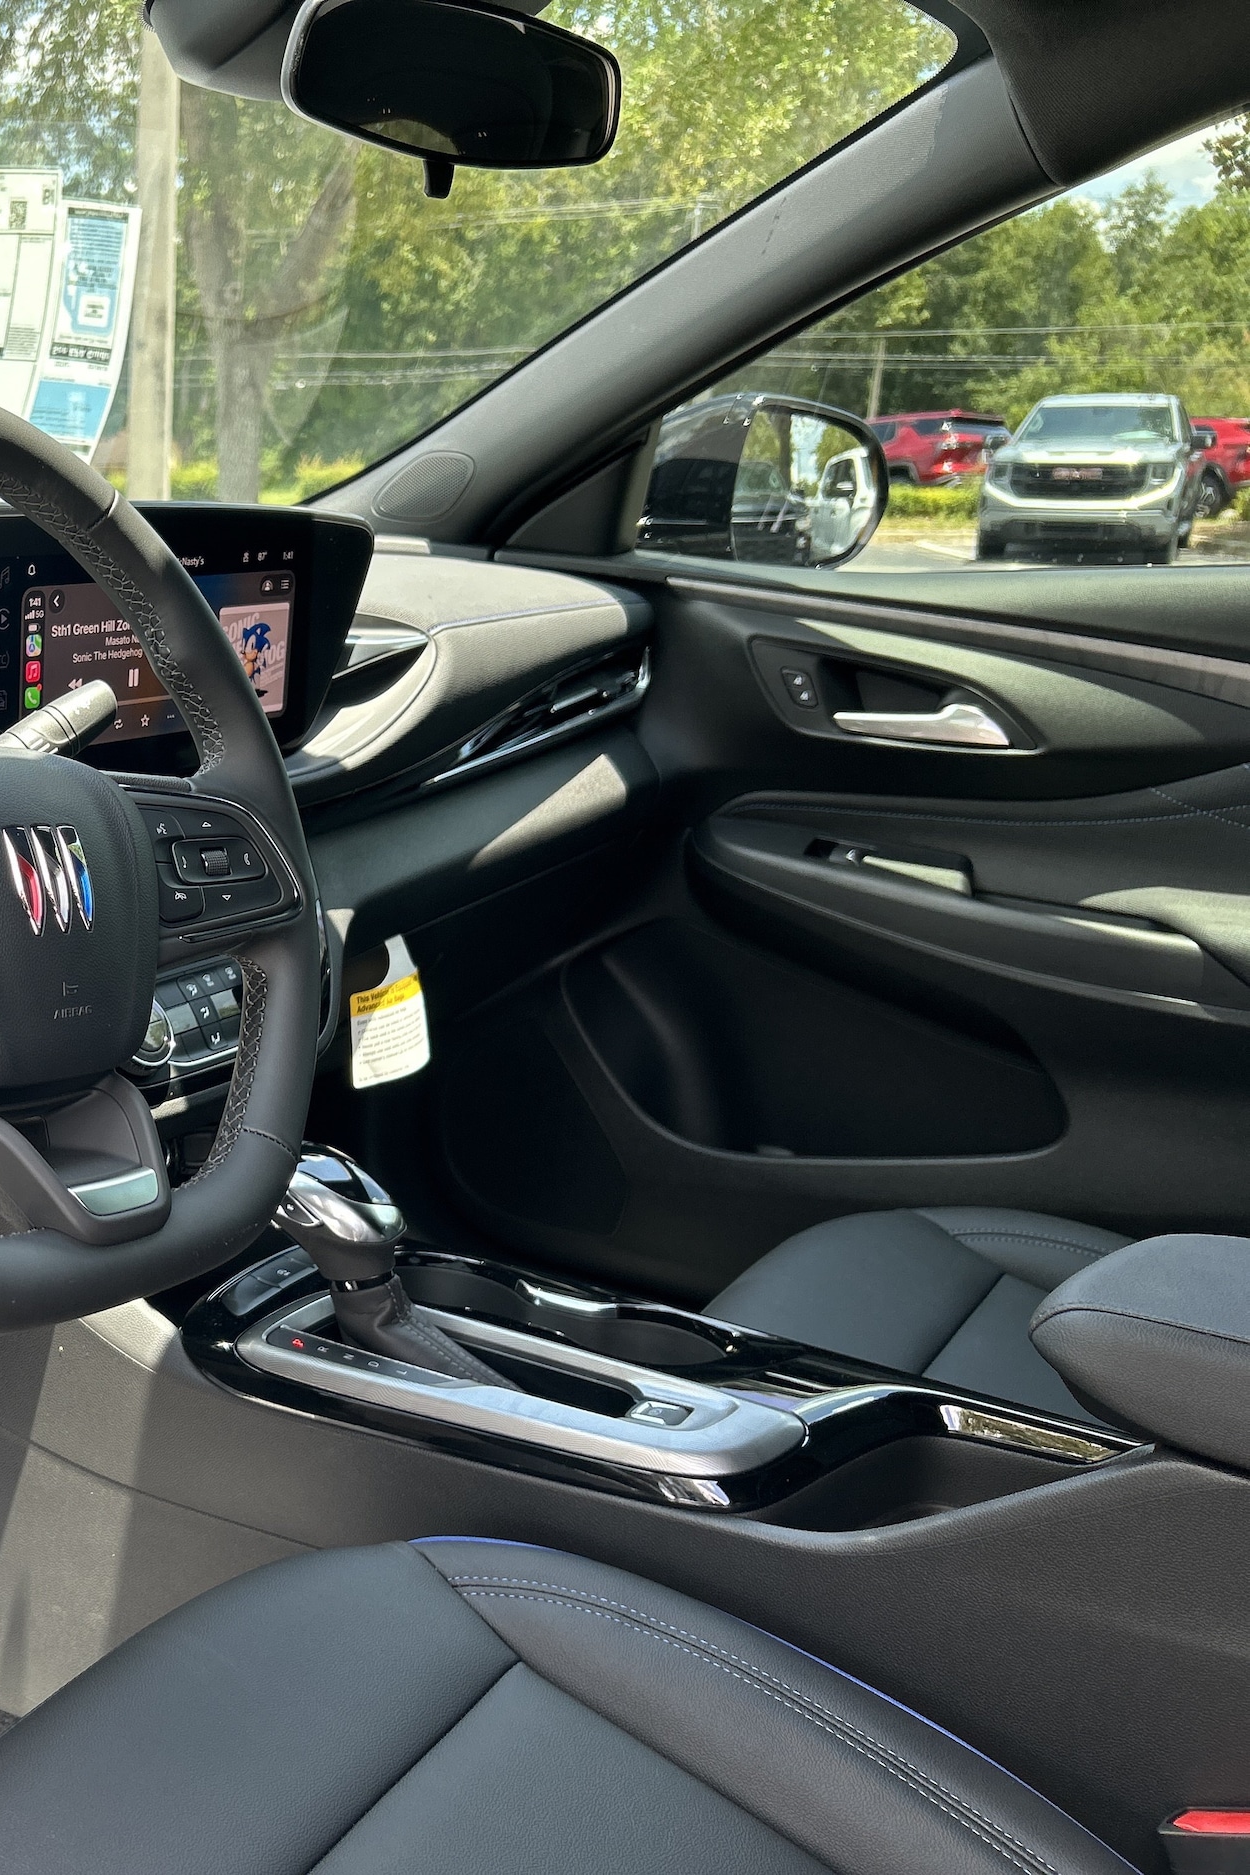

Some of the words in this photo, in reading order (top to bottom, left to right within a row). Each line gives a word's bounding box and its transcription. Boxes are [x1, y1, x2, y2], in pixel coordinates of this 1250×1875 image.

[28, 597, 41, 607] 1:41
[36, 610, 45, 619] 5G
[51, 624, 71, 638] Sth1
[73, 622, 100, 636] Green
[101, 621, 115, 632] Hill
[105, 635, 130, 646] Masato
[72, 652, 92, 663] Sonic
[93, 650, 106, 660] The
[108, 647, 143, 660] Hedgehog
[317, 1345, 329, 1353] R
